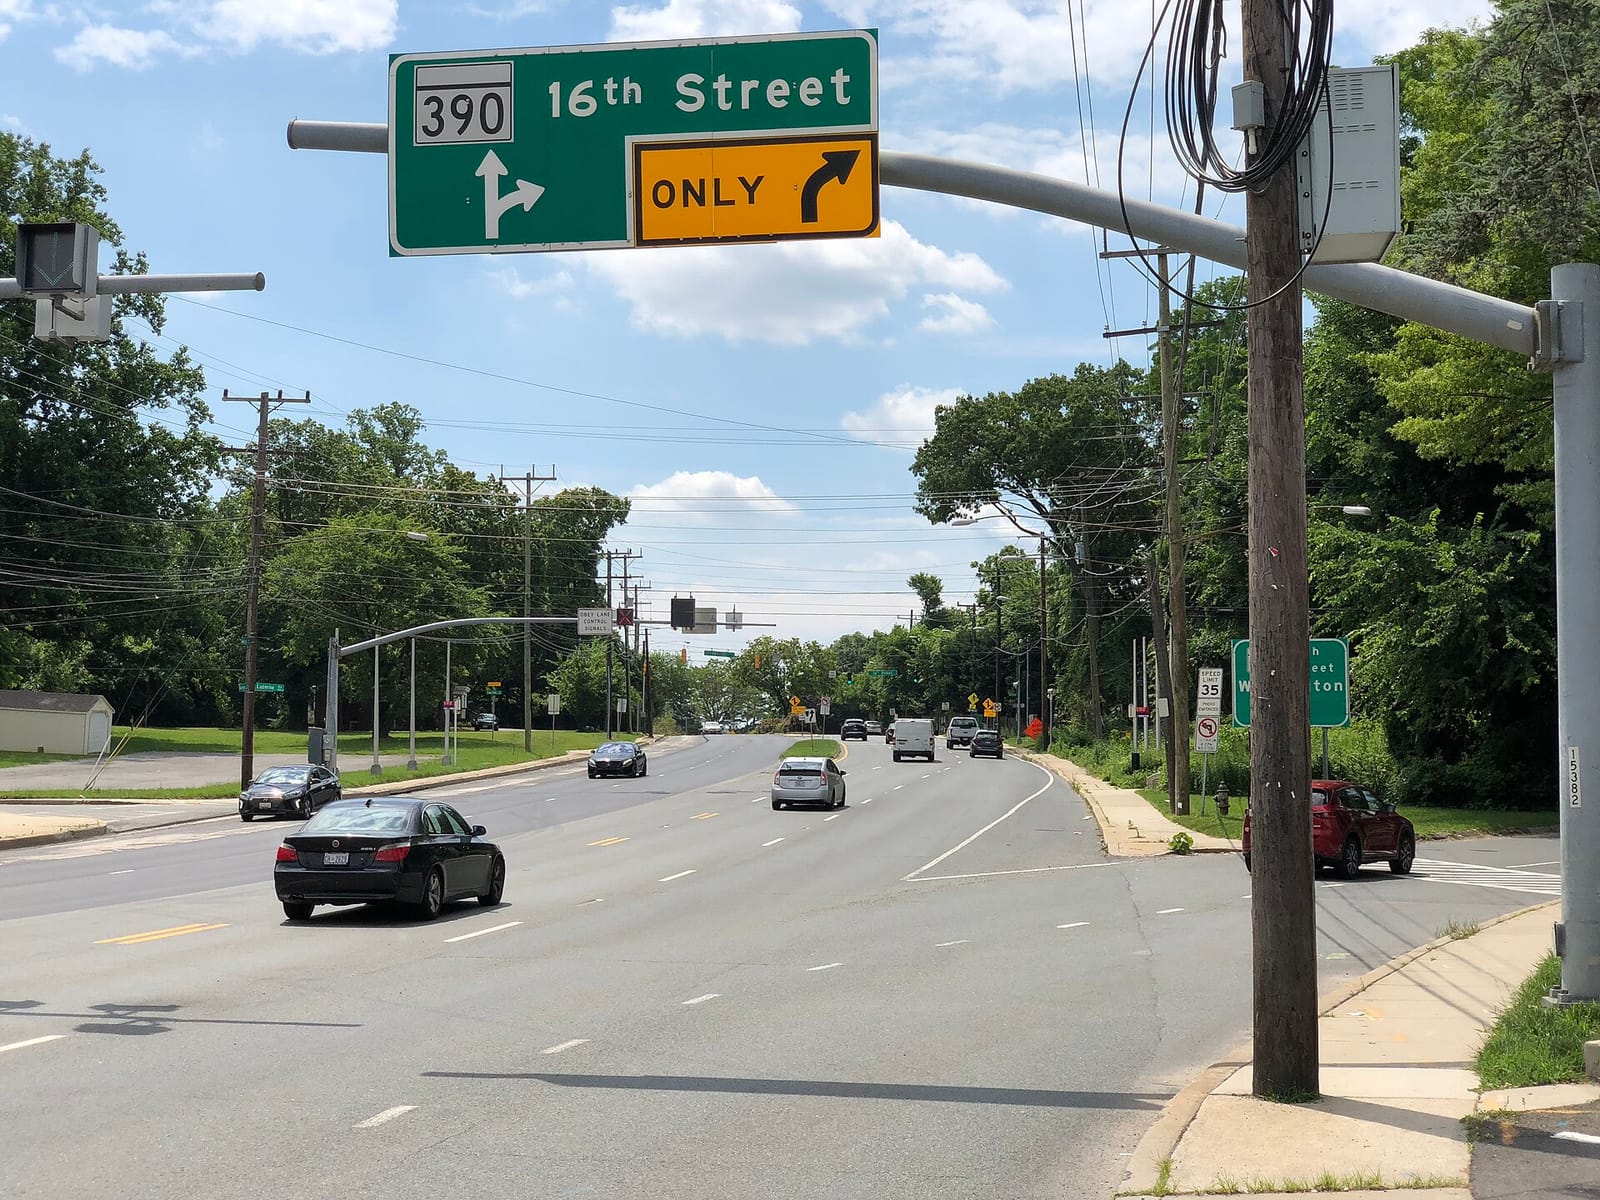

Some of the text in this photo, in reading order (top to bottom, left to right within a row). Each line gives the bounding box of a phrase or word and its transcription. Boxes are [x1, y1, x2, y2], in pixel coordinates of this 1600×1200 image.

[421, 92, 505, 138] 390
[548, 67, 852, 118] 16th Street
[651, 175, 765, 210] ONLY
[1201, 684, 1219, 696] 35
[1570, 749, 1579, 806] 15382
